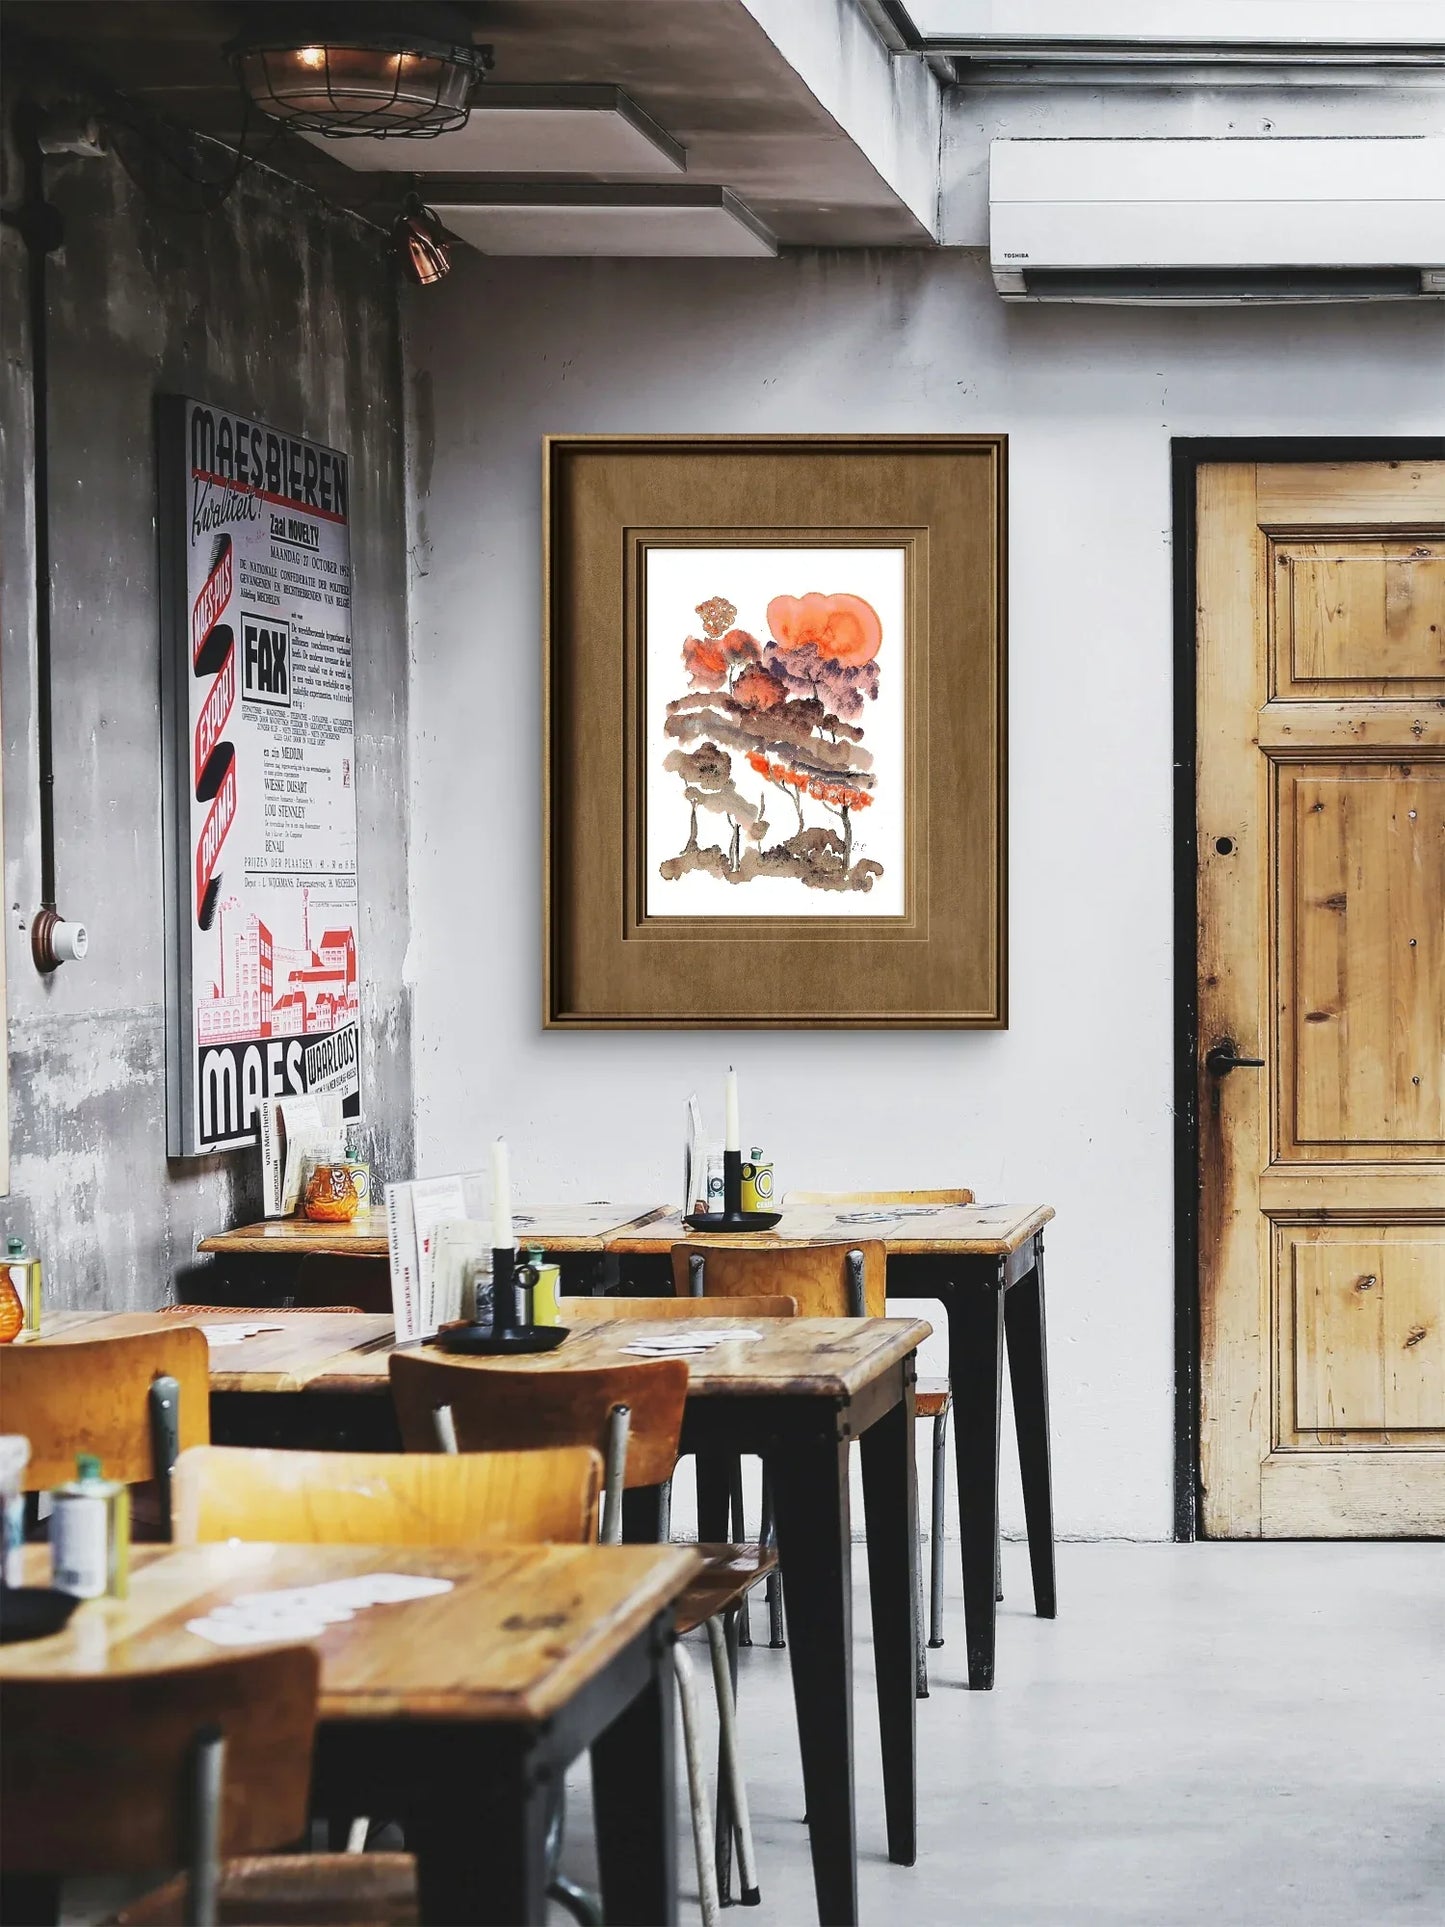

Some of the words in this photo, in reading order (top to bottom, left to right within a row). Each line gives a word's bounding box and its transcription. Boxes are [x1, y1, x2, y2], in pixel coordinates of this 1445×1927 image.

[270, 513, 285, 537] Zaal
[288, 518, 320, 546] NOVELTY
[240, 559, 247, 569] DE
[270, 545, 300, 565] MAANDAG
[311, 556, 337, 574] OCTOBER
[244, 624, 287, 695] FAX
[200, 649, 233, 767] EXPORT
[203, 772, 234, 886] PRIMA
[202, 1040, 304, 1138] MAES
[306, 1028, 356, 1085] WAARLOOS
[261, 1103, 270, 1148] Mechelen
